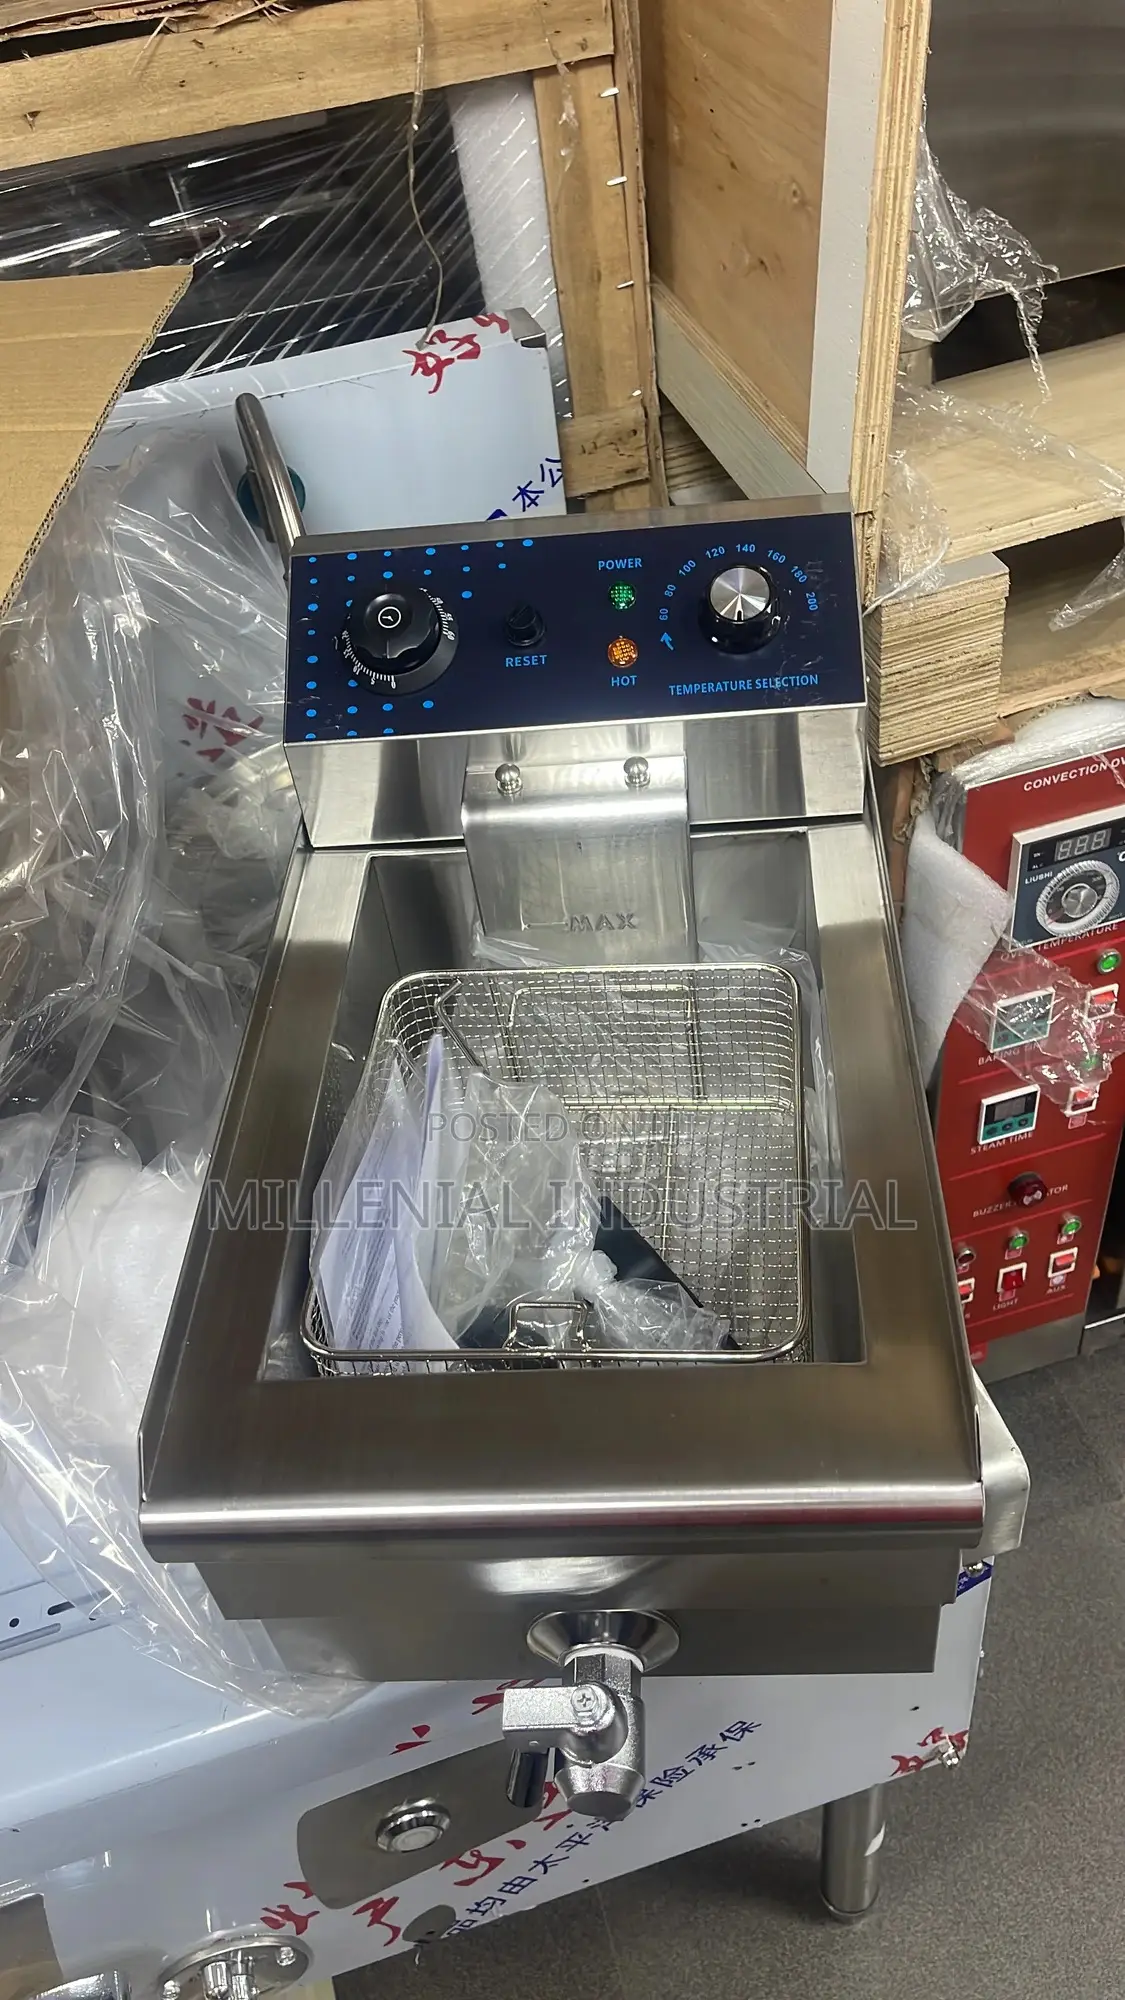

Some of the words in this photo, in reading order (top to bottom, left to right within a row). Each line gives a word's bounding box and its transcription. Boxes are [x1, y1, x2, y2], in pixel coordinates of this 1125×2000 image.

[598, 557, 643, 571] POWER
[659, 607, 669, 621] 60
[664, 583, 677, 598] 80
[678, 559, 697, 577] 100
[705, 545, 726, 560] 120
[735, 543, 756, 553] 140
[766, 549, 787, 564] 160
[790, 565, 808, 583] 180
[805, 591, 819, 612] 200
[505, 655, 548, 668] RESET
[611, 675, 638, 687] HOT
[669, 678, 753, 696] TEMPERATURE
[755, 674, 819, 690] SELECTION
[1023, 762, 1107, 791] CONVECTION
[570, 912, 637, 932] MAX
[970, 1138, 1006, 1155] STEAM
[1008, 1131, 1033, 1144] TIME
